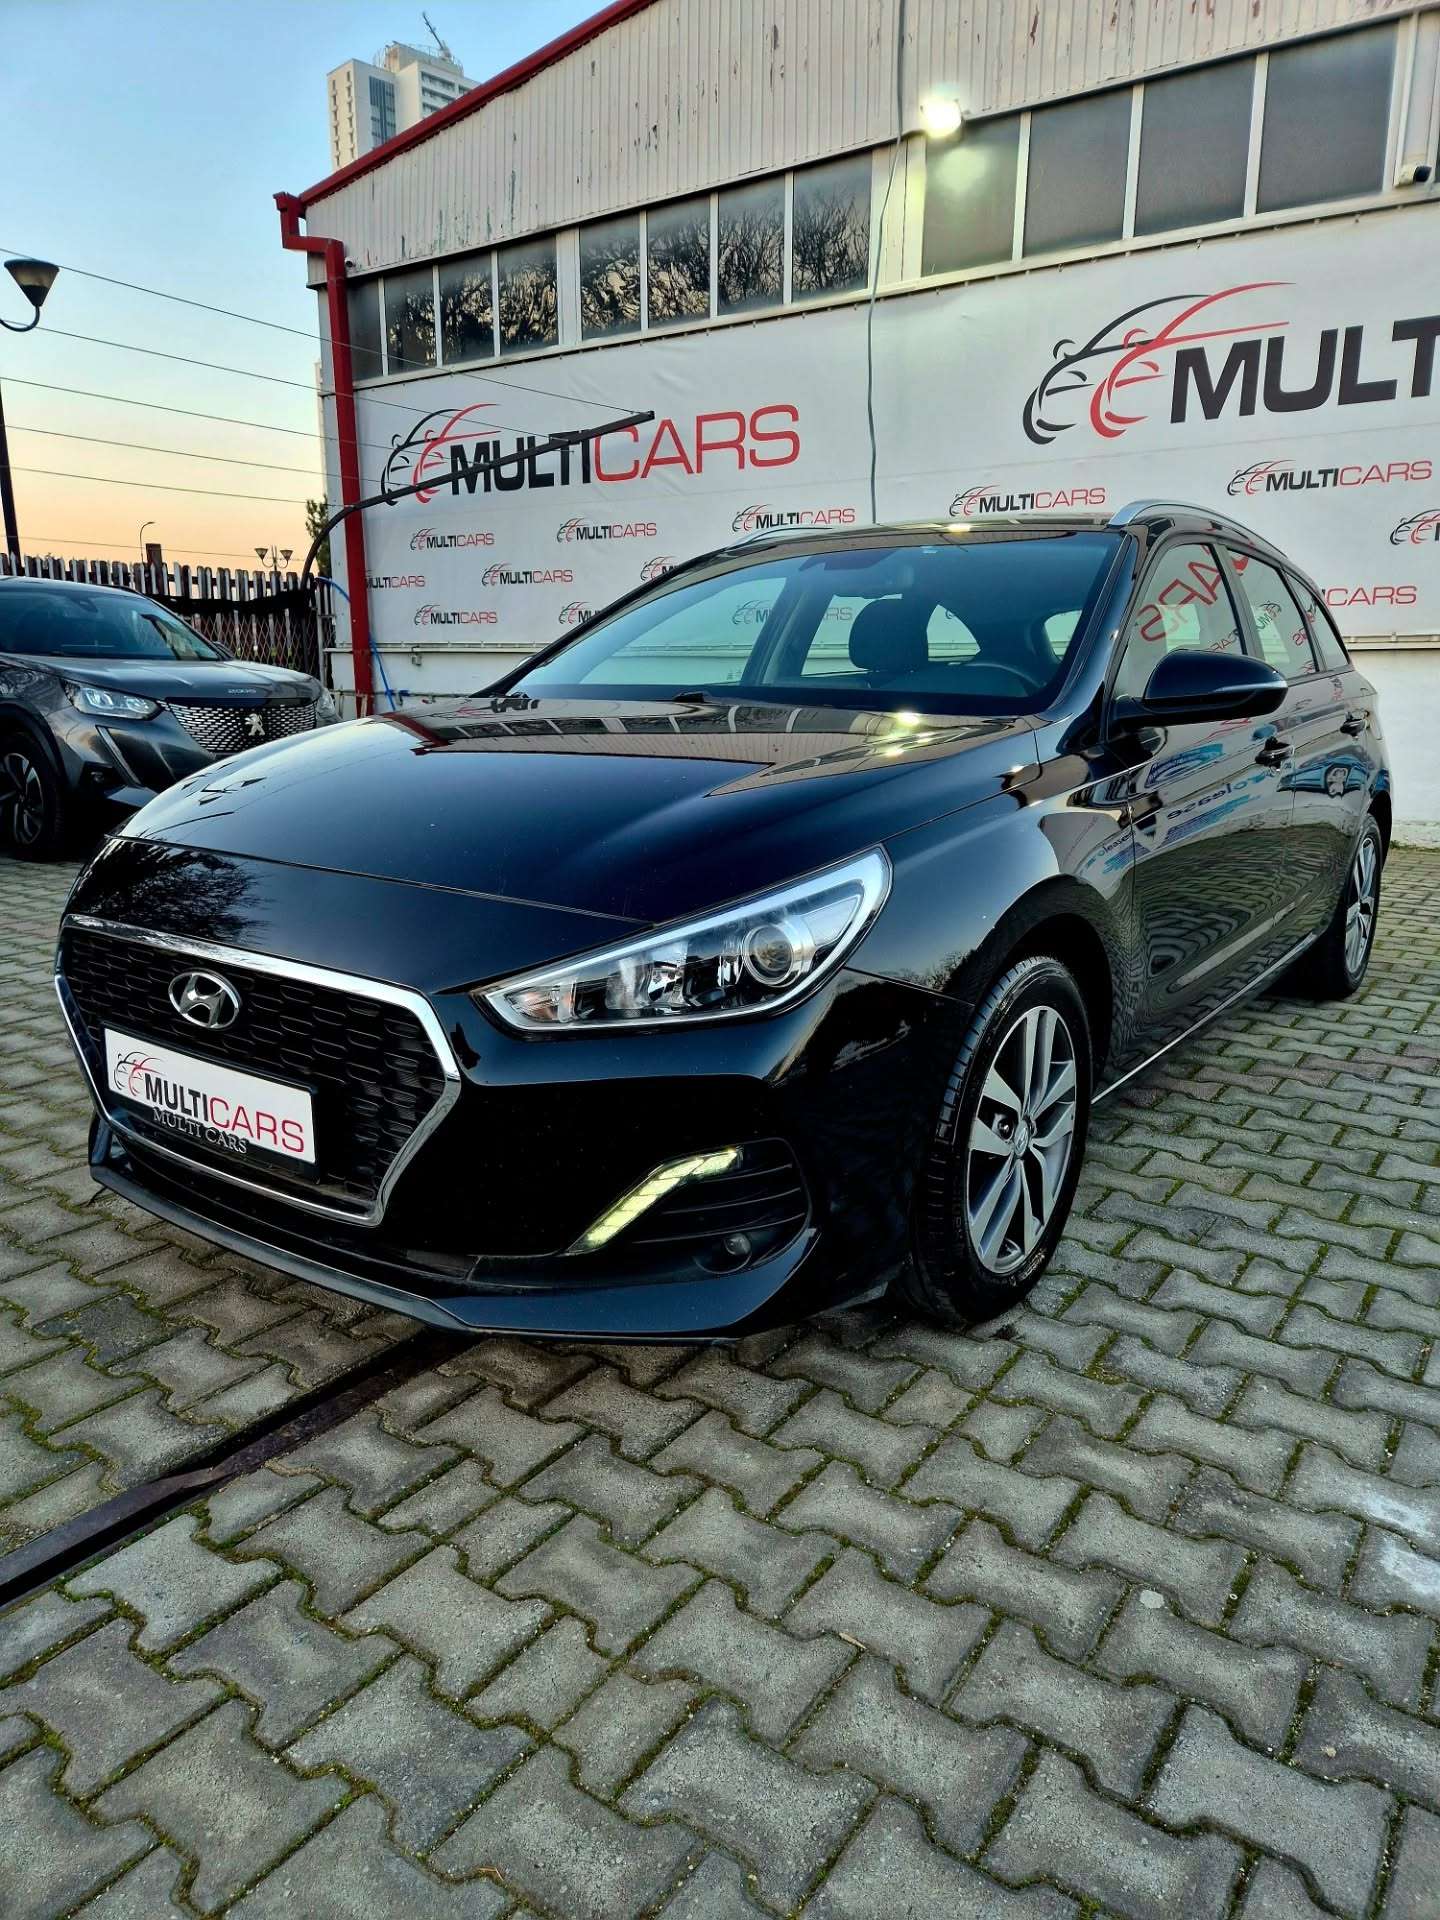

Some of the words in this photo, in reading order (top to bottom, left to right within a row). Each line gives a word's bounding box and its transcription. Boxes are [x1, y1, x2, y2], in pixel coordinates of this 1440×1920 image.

[450, 404, 800, 496] MULTICARS
[1265, 460, 1433, 493] MULTICARS
[979, 487, 1106, 514] MULTICARS
[755, 508, 856, 530] MULTICARS
[426, 532, 495, 549] MULTICARS
[576, 522, 657, 541] MULTICARS
[499, 569, 574, 585] MULTICARS
[430, 611, 498, 625] MULTICARS
[144, 1072, 305, 1154] MULTICARS
[153, 1107, 202, 1139] MULTI
[205, 1126, 249, 1156] CARS
